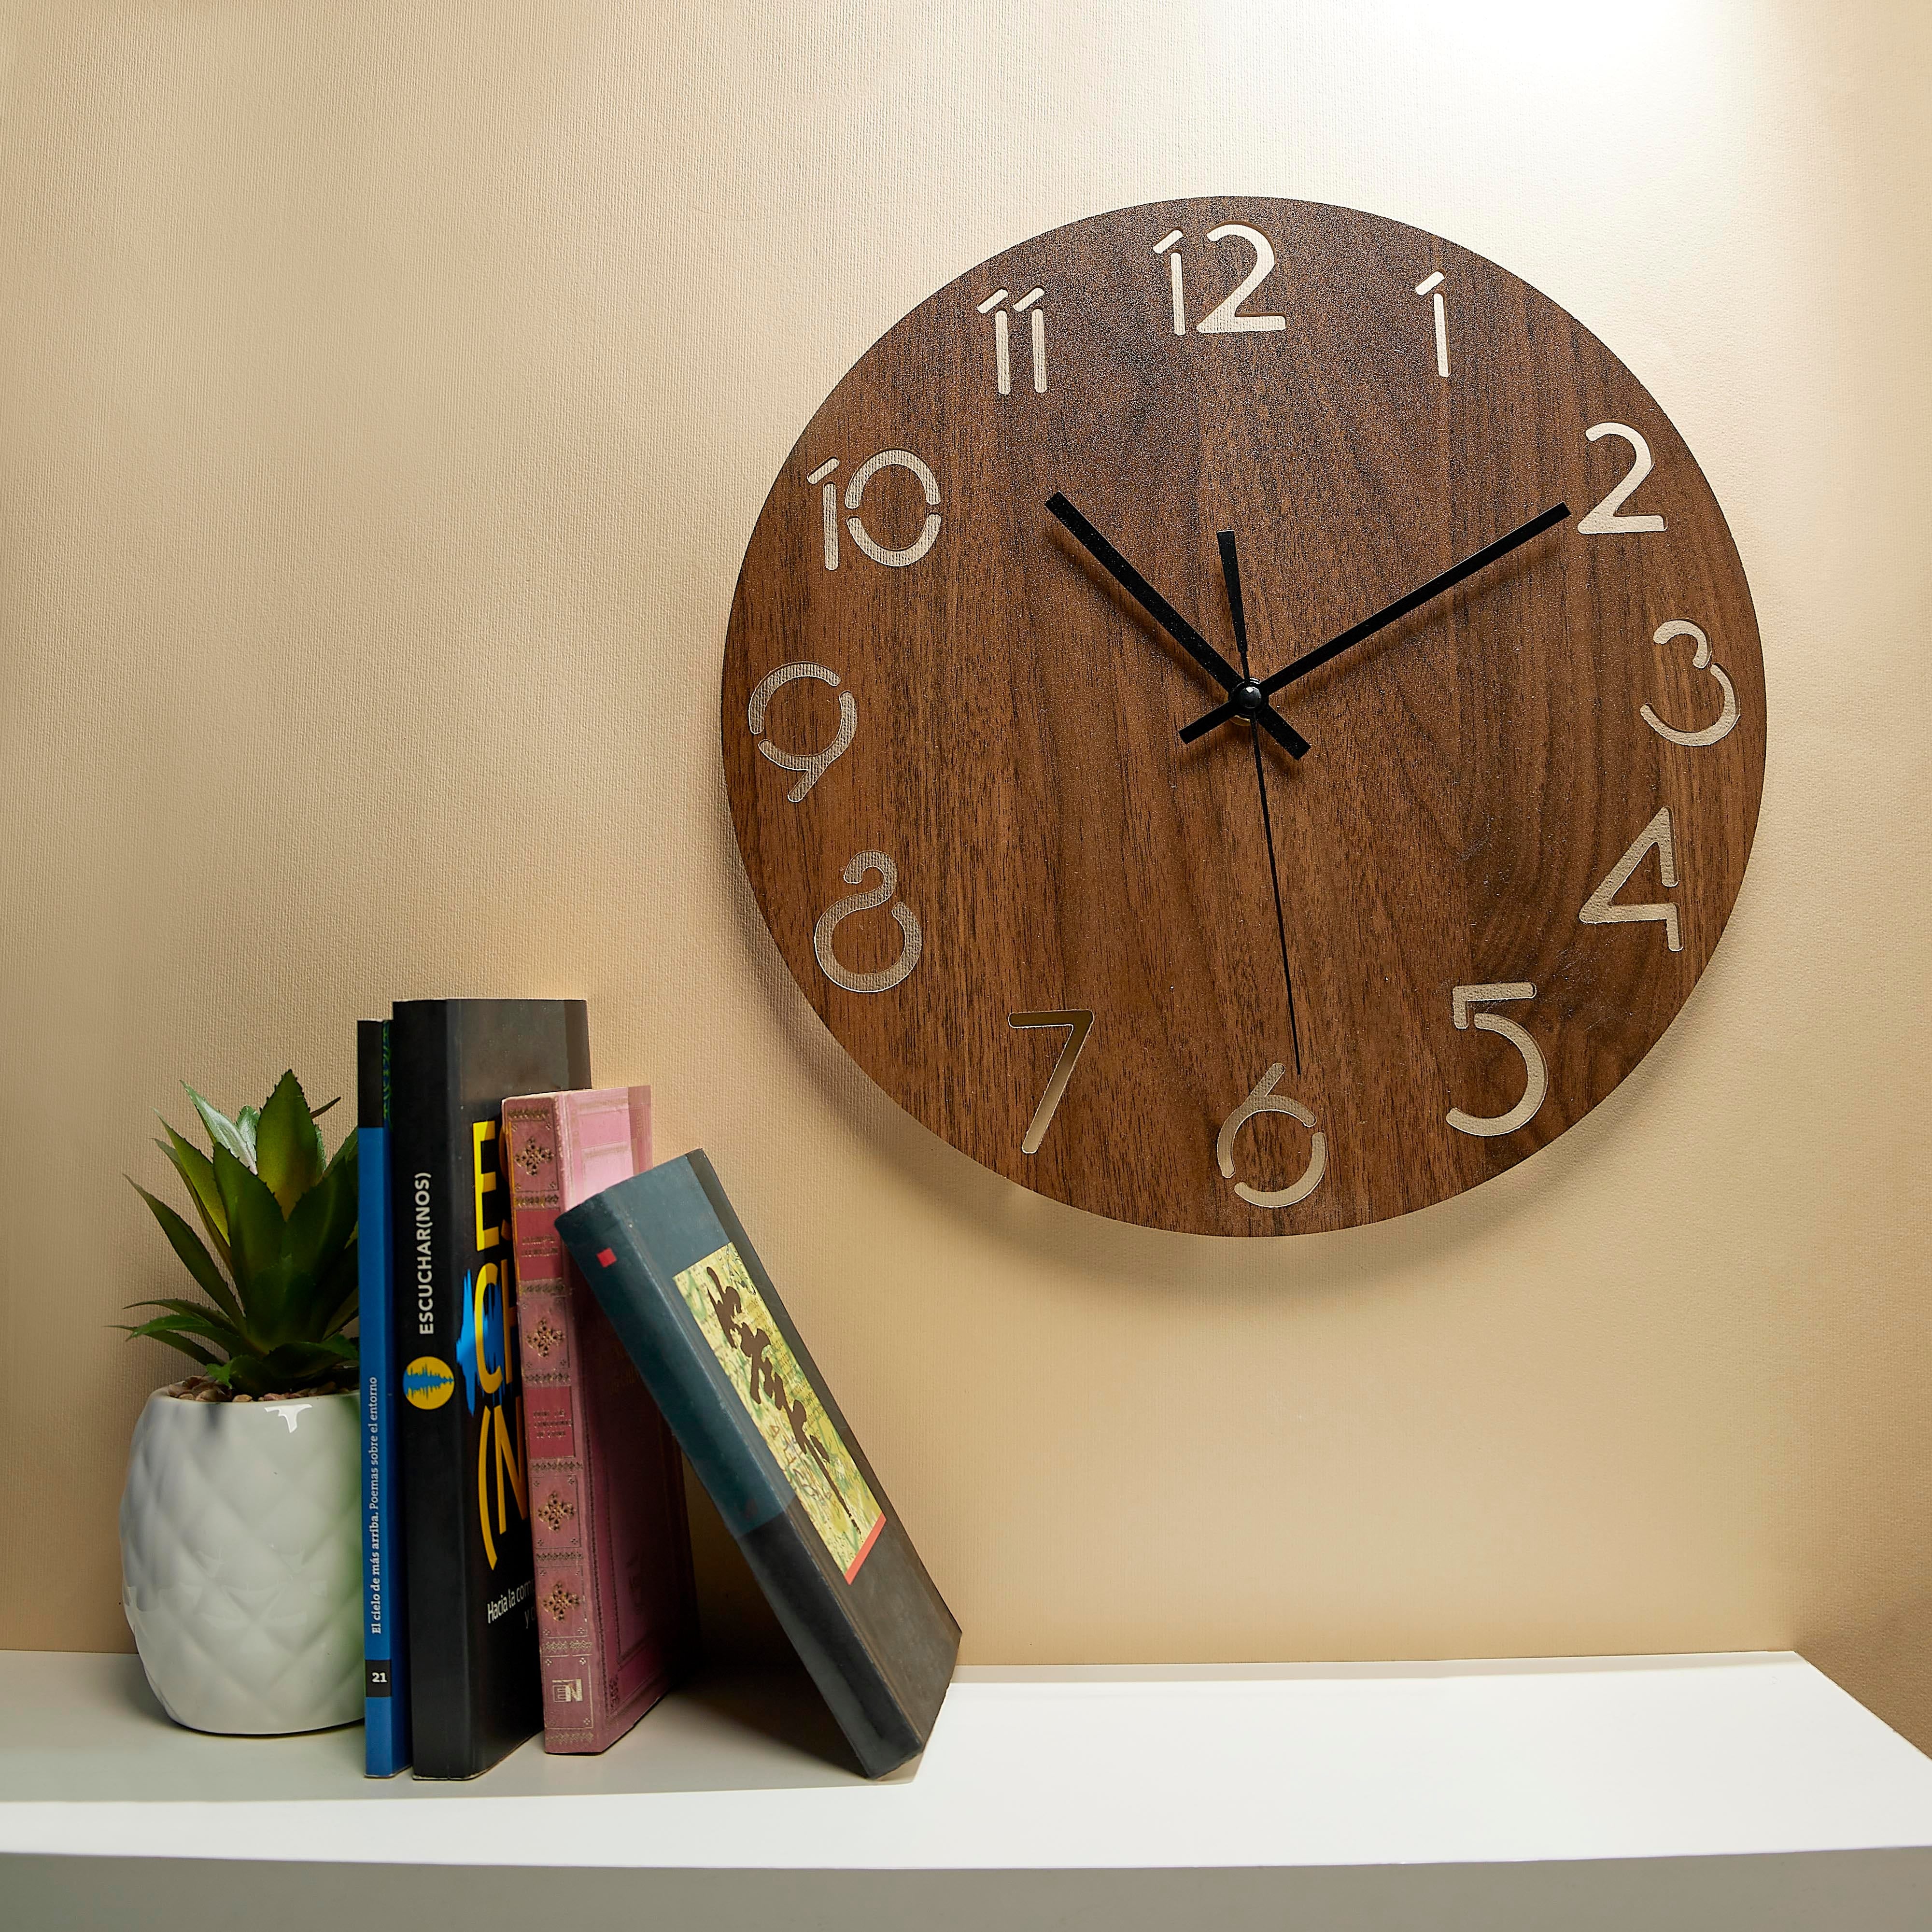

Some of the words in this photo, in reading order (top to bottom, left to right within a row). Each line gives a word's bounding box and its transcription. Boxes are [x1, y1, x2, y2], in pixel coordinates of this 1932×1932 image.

[1151, 219, 1286, 336] 12
[1415, 269, 1451, 378] 1
[976, 286, 1046, 396] 11
[806, 447, 942, 572] 10
[1576, 421, 1667, 535] 2
[747, 660, 858, 804] 9
[1639, 617, 1741, 747] 3
[813, 849, 923, 994] 8
[1578, 805, 1684, 953] 4
[1007, 1008, 1094, 1154] 7
[1445, 981, 1549, 1137] 5
[1216, 1061, 1327, 1209] 6
[414, 1172, 434, 1335] ESCUCHAR(NOS)
[367, 1423, 378, 1433] el
[368, 1377, 378, 1421] entorno
[368, 1435, 378, 1466] sobre
[369, 1467, 379, 1510] Poemas
[369, 1511, 380, 1549] arriba.
[369, 1551, 380, 1576] más
[370, 1578, 381, 1592] de
[370, 1594, 381, 1621] cielo
[487, 1594, 508, 1623] Hacia
[508, 1588, 516, 1608] la
[371, 1622, 381, 1634] El
[371, 1672, 388, 1683] 21
